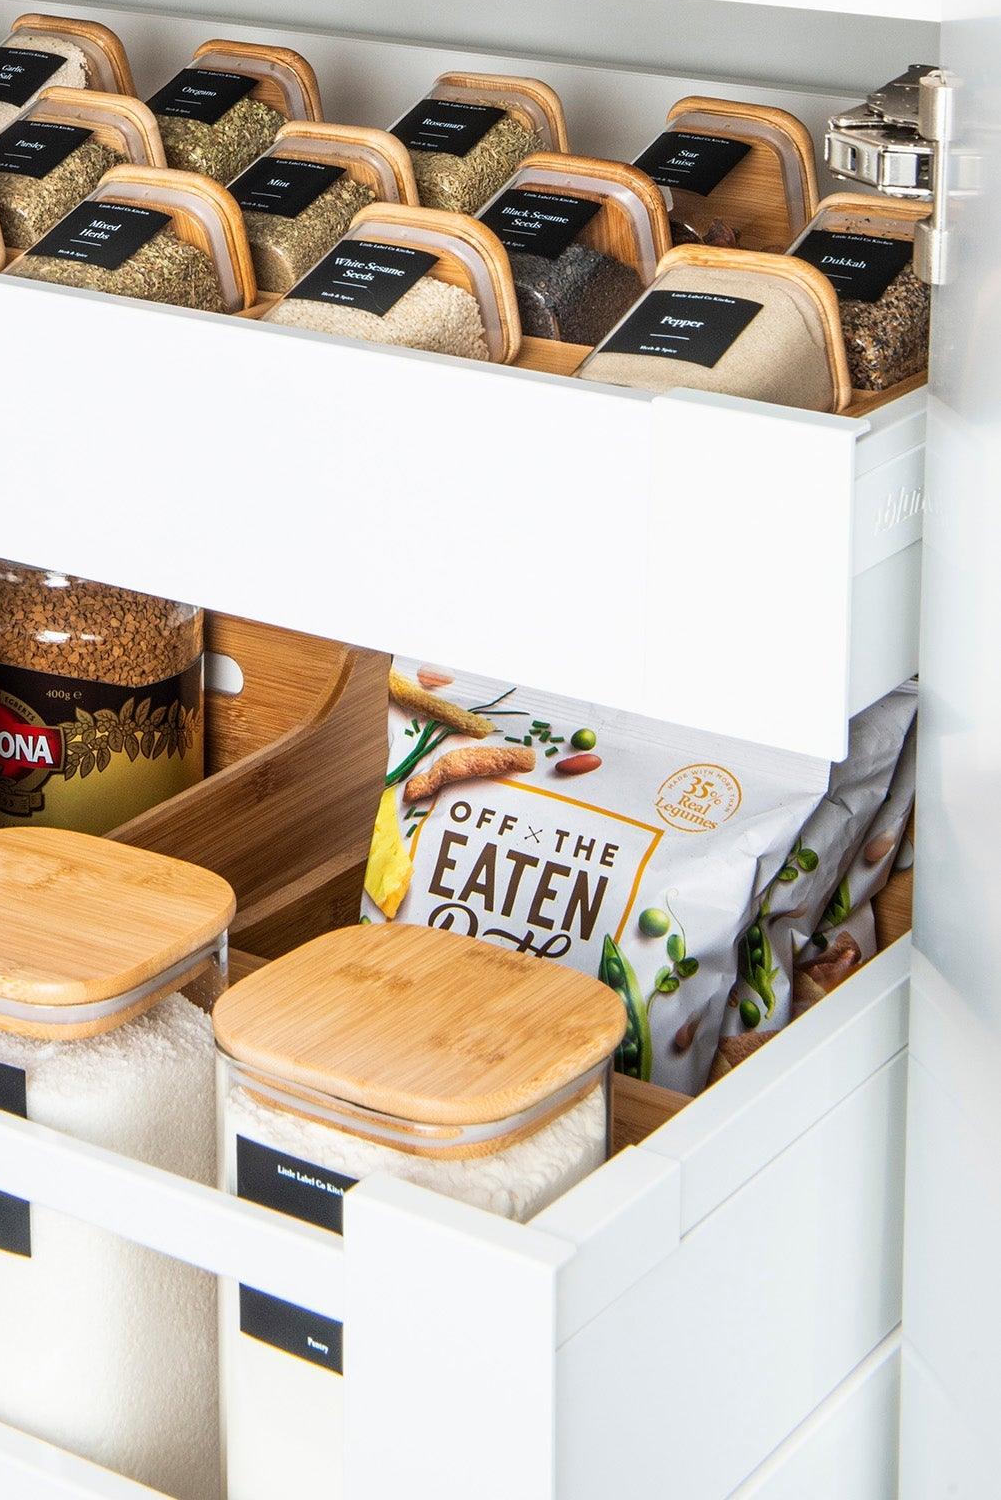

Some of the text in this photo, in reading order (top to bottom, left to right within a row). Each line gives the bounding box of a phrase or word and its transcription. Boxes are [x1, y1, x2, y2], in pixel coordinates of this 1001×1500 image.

[1, 63, 26, 73] Garlic
[180, 85, 217, 98] Oregano
[421, 117, 467, 131] Rosemary
[15, 139, 47, 151] Parsley
[677, 149, 700, 159] Star
[666, 157, 696, 167] Anise
[266, 178, 291, 189] Mint
[501, 206, 570, 224] Black Sesame
[88, 218, 123, 232] Mixed
[511, 217, 543, 230] Seeds
[78, 228, 110, 241] Herbs
[334, 257, 405, 277] White Sesame
[821, 254, 867, 269] Dukkah
[342, 269, 375, 282] Seeds
[660, 315, 705, 329] Pepper
[45, 689, 71, 701] 400g
[682, 776, 723, 806] 35%
[677, 794, 711, 815] Real
[654, 797, 718, 830] Legumes
[449, 801, 620, 868] OFF THE
[428, 829, 609, 941] EATEN
[277, 1164, 296, 1179] Little
[296, 1171, 315, 1186] Label
[315, 1179, 326, 1190] Co
